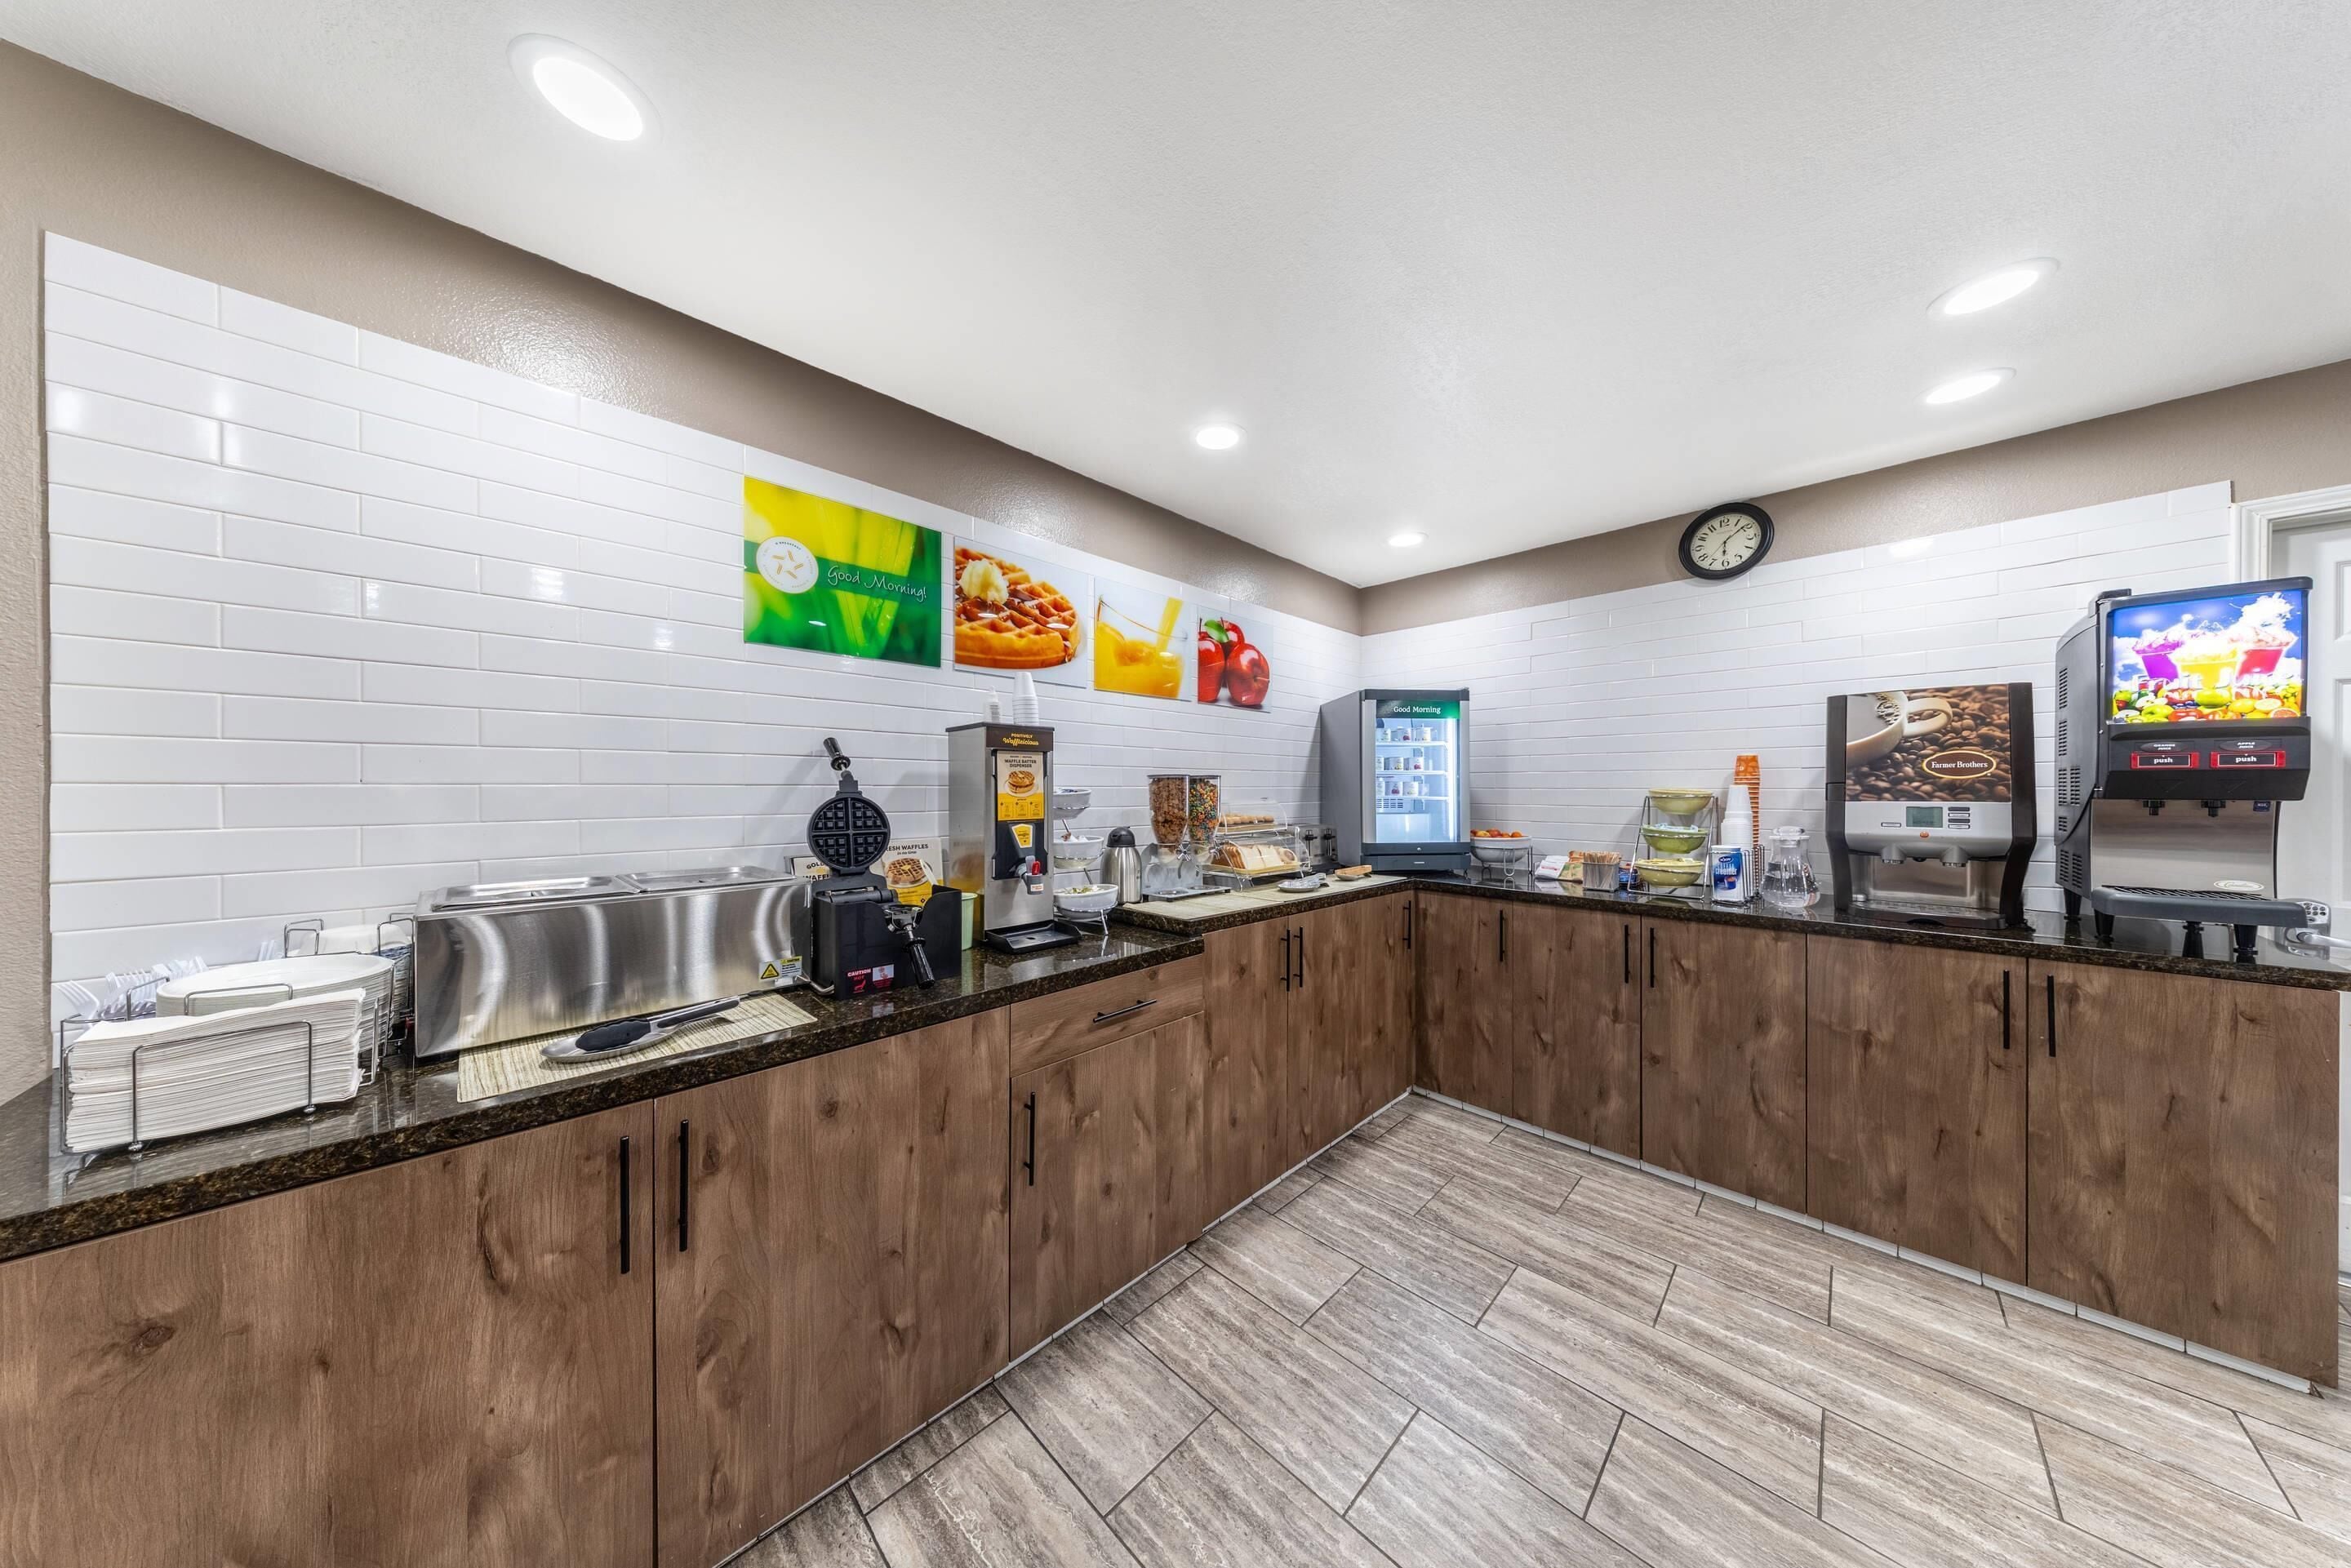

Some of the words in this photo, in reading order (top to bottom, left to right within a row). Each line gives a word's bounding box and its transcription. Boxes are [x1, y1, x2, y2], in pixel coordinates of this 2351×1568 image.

[1719, 517, 1730, 528] 12
[1698, 532, 1709, 542] 10
[1722, 558, 1730, 567] 6
[828, 565, 860, 586] Good
[864, 574, 927, 602] Morning!
[1412, 706, 1442, 714] Morning
[1957, 760, 1989, 768] Brothers
[1715, 867, 1737, 876] creamer
[847, 968, 871, 977] CAUTION
